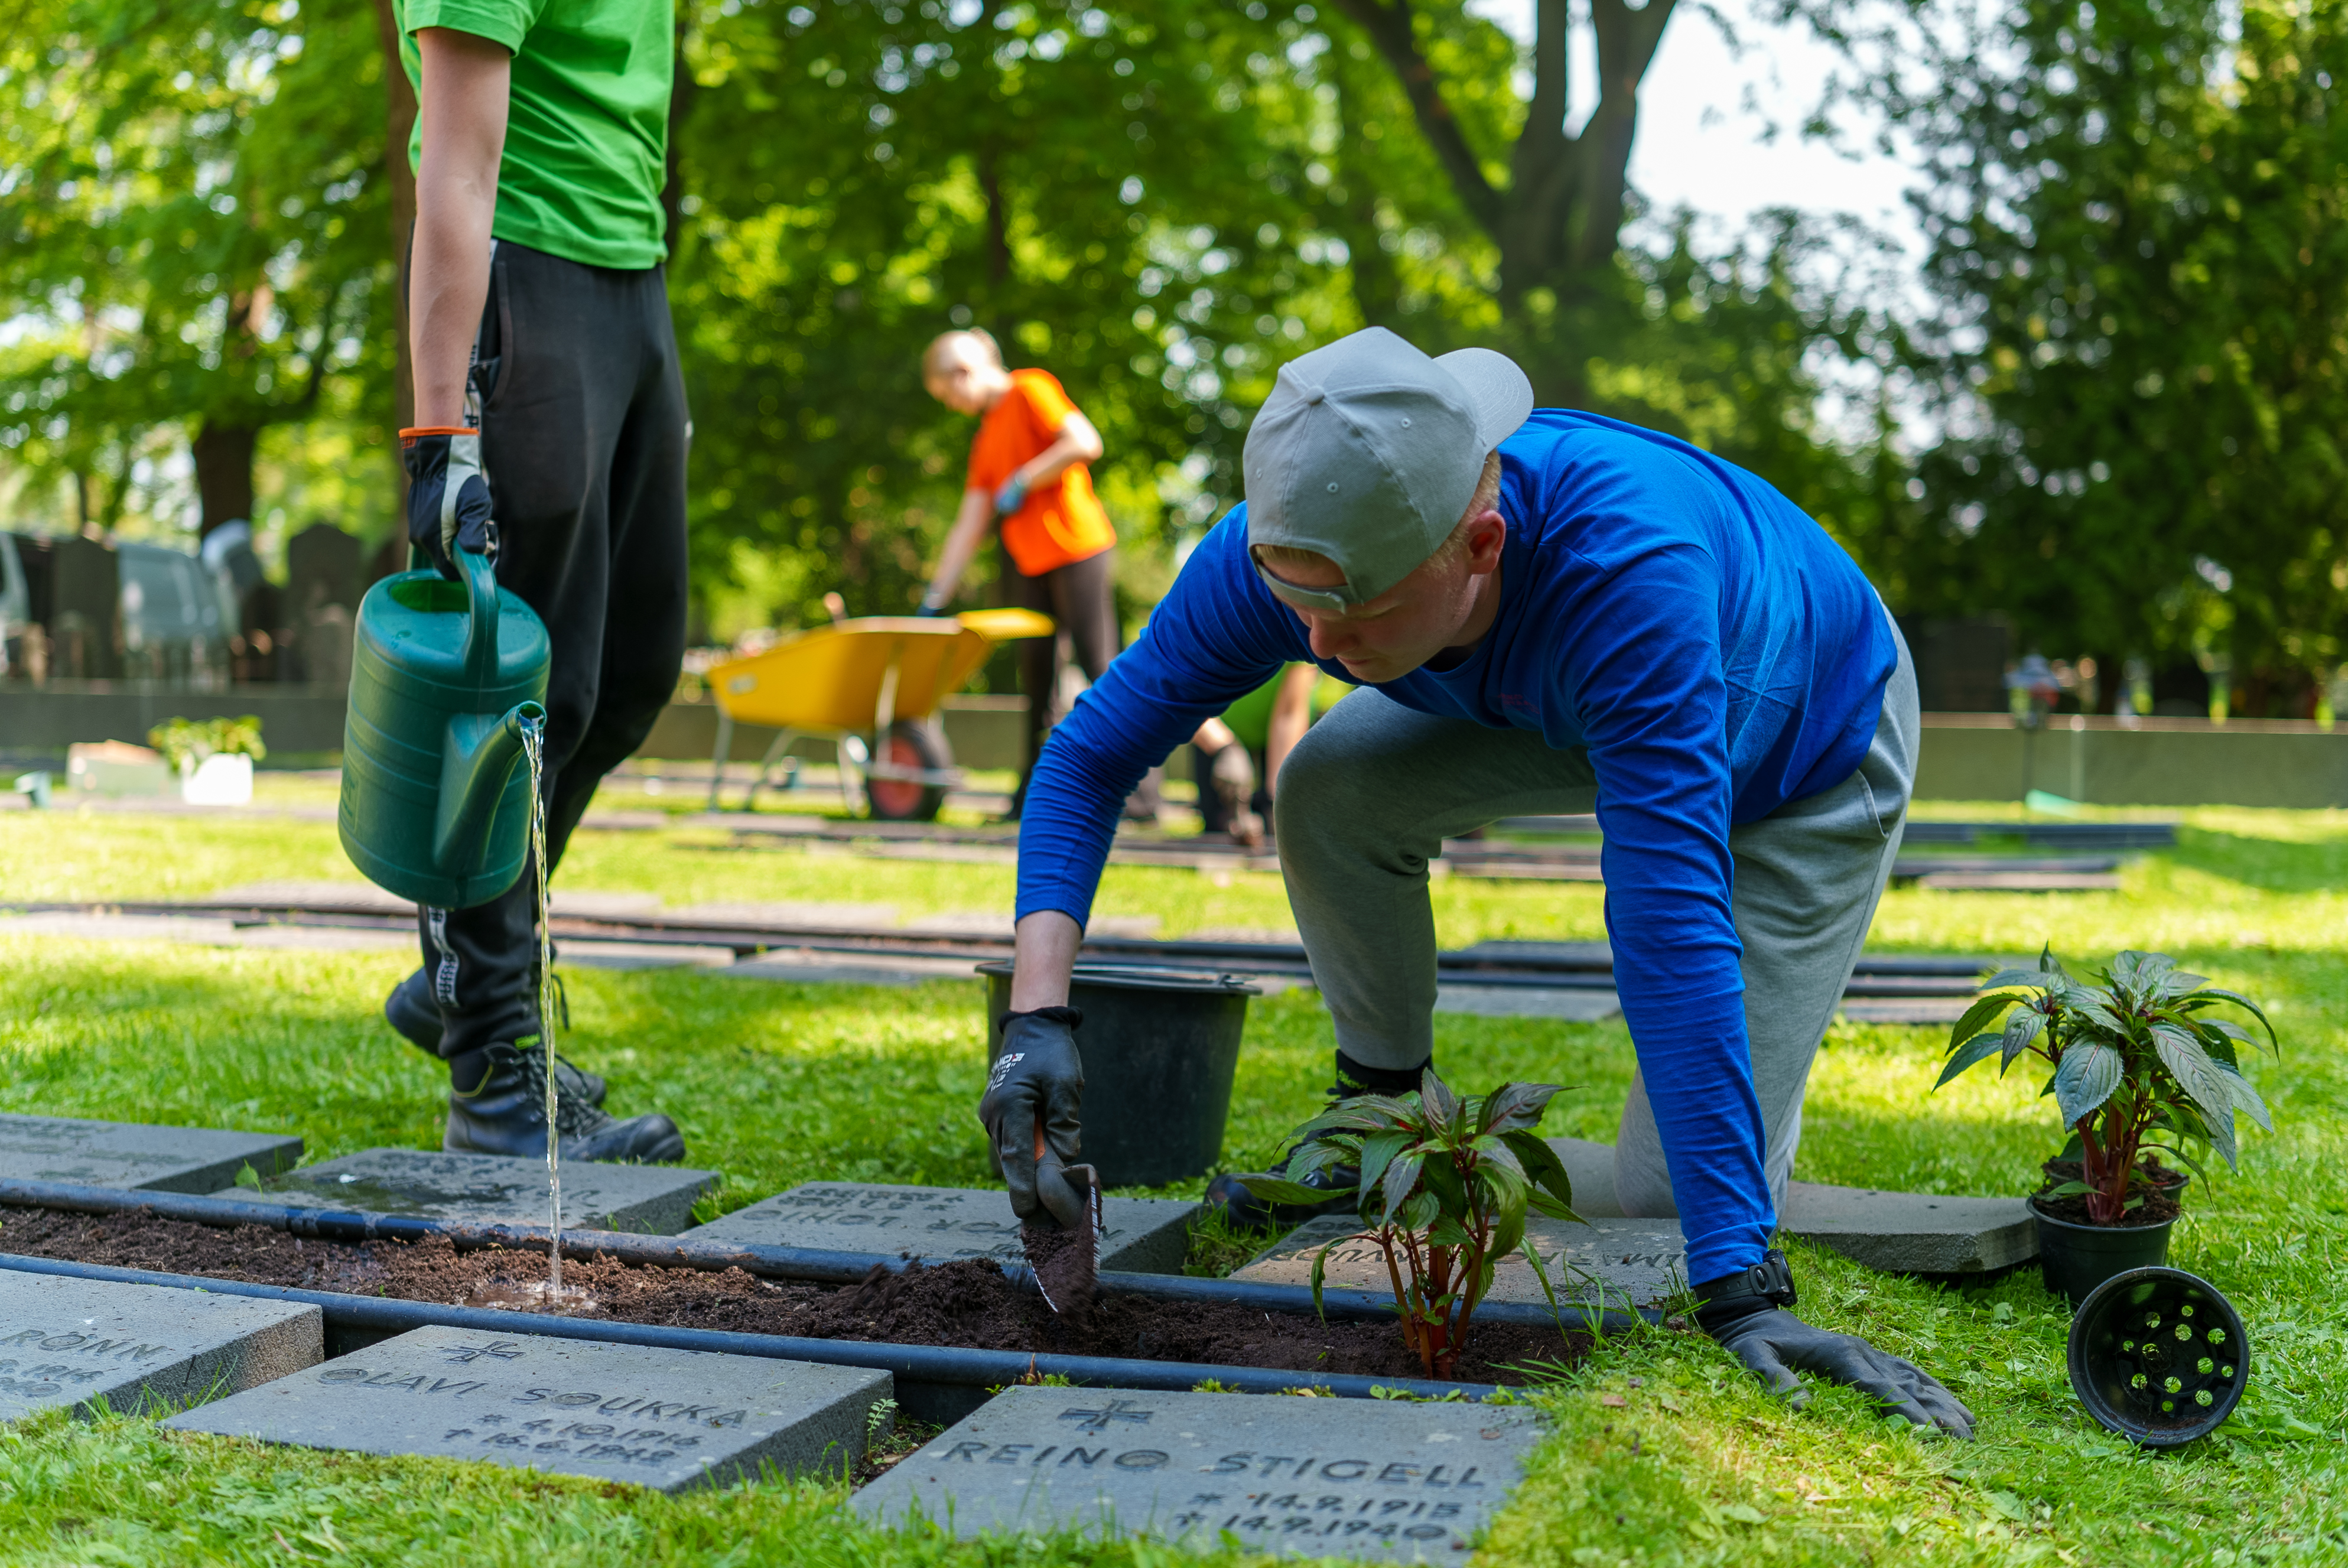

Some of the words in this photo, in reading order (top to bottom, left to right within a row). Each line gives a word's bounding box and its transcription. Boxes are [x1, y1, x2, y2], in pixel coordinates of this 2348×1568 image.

[317, 1368, 489, 1398] OLAVI
[510, 1387, 749, 1429] SOUKKA
[938, 1440, 1172, 1472] REINO
[1211, 1453, 1487, 1488] STIGELL
